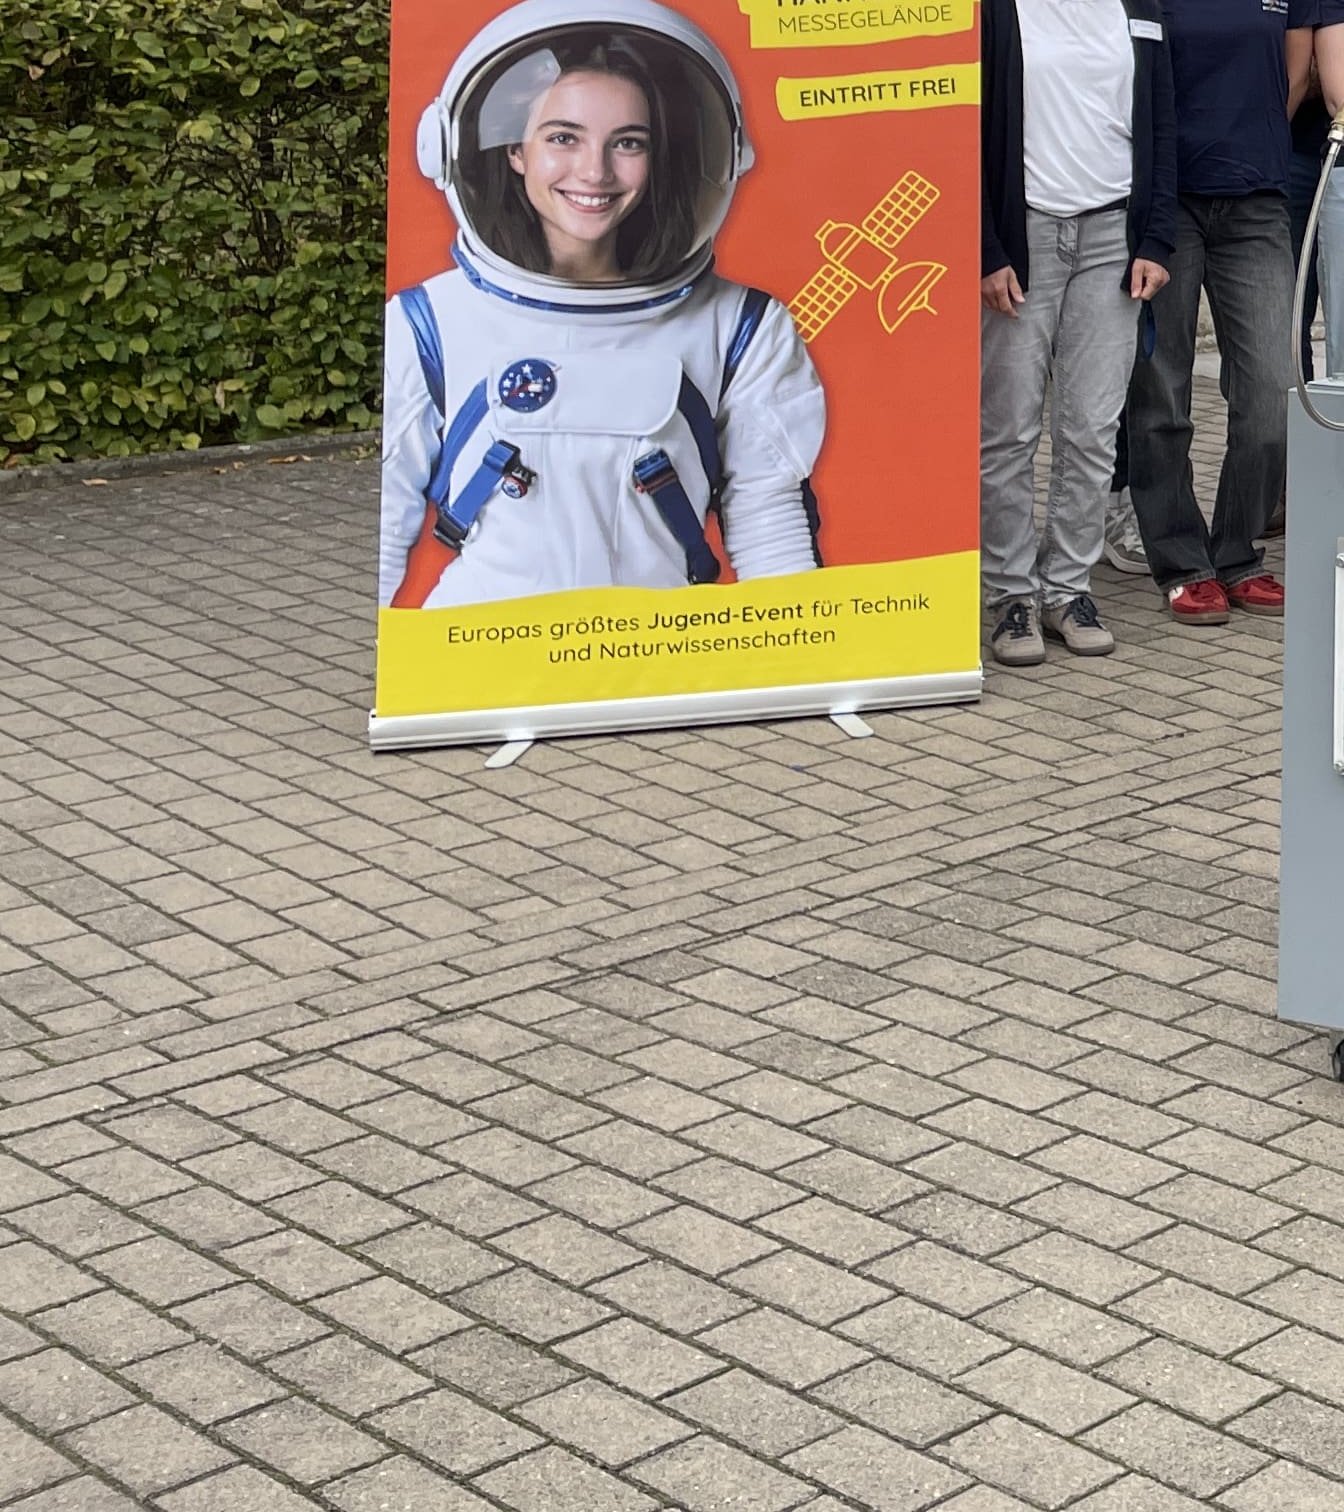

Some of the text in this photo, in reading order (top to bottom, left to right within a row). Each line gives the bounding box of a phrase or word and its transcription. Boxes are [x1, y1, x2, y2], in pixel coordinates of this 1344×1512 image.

[777, 4, 954, 35] MESSEGELÄNDE
[799, 78, 957, 108] EINTRITT FREI
[447, 593, 931, 645] Europas größtes Jugend-Event für Technik
[548, 626, 837, 664] und Naturwissenschaften
